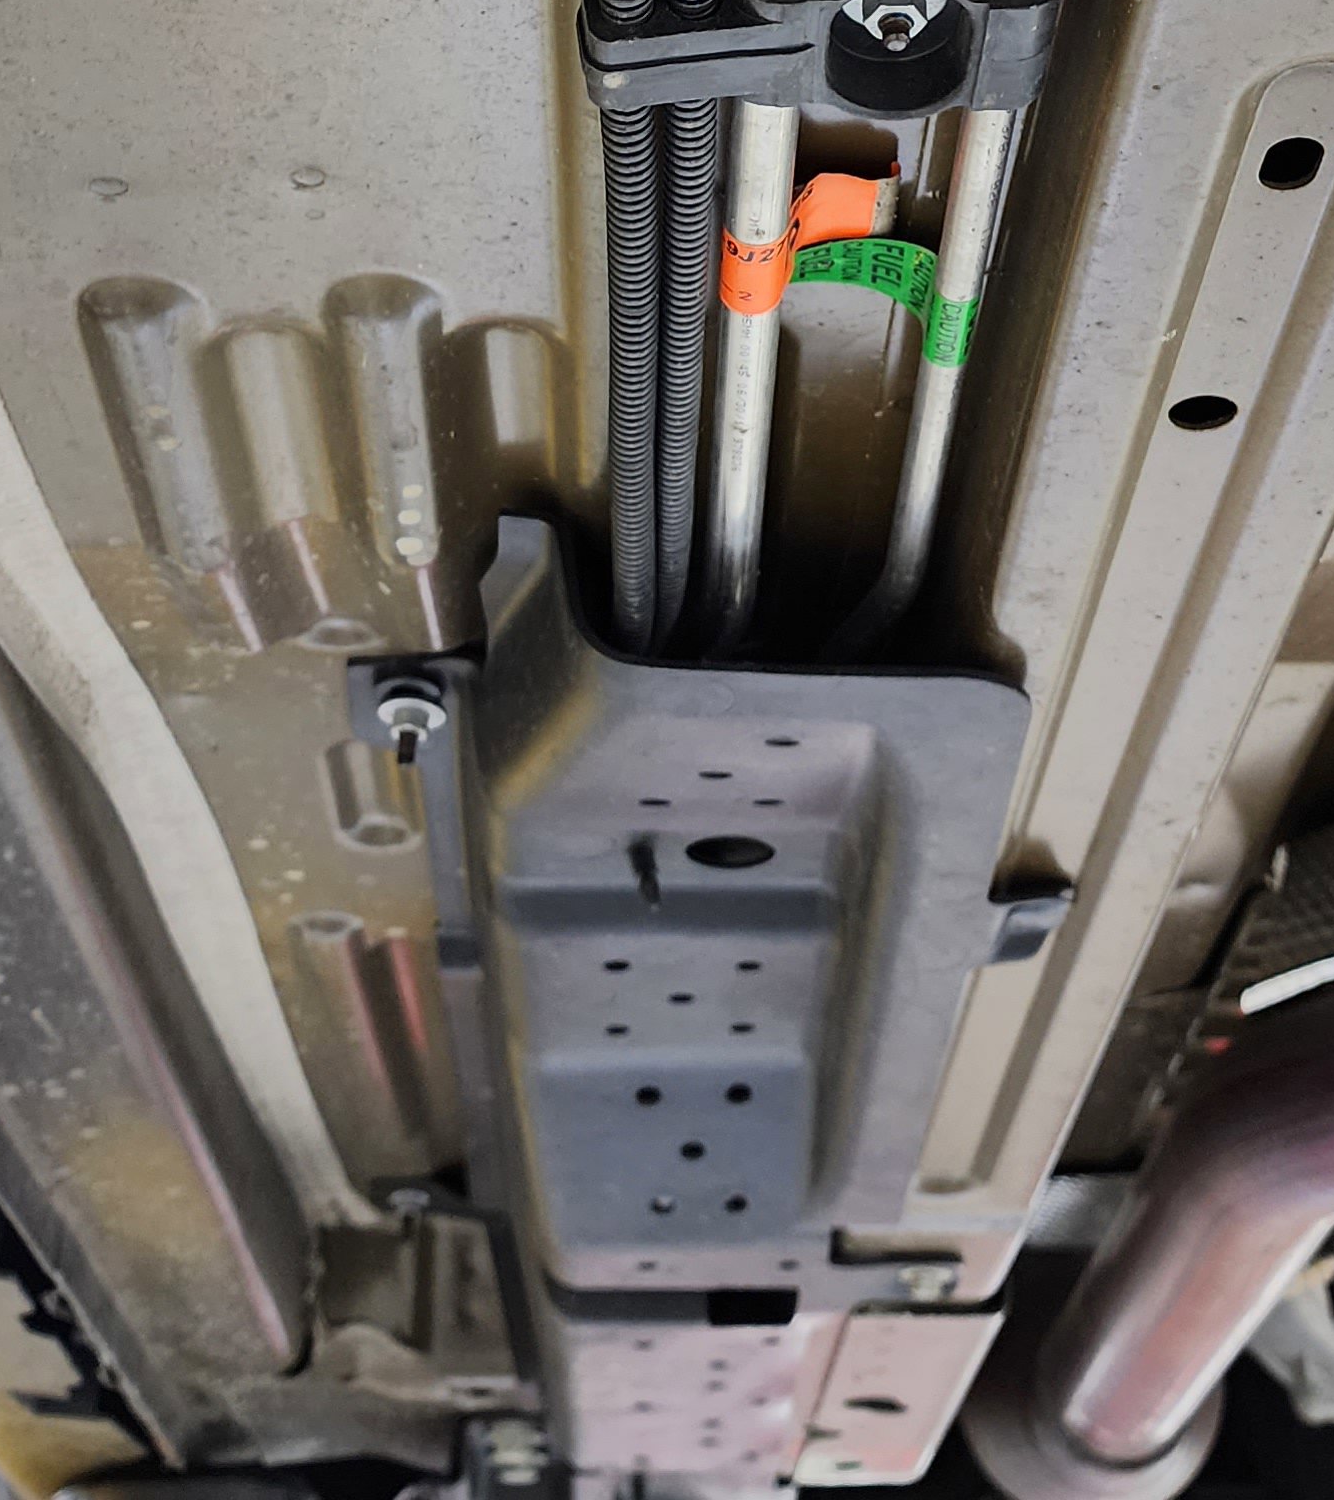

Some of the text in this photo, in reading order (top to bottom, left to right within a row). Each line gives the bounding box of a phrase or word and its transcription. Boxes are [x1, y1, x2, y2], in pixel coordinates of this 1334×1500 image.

[870, 242, 906, 290] FUEL
[906, 251, 934, 313] CAUTION
[933, 302, 963, 365] CAUTION
